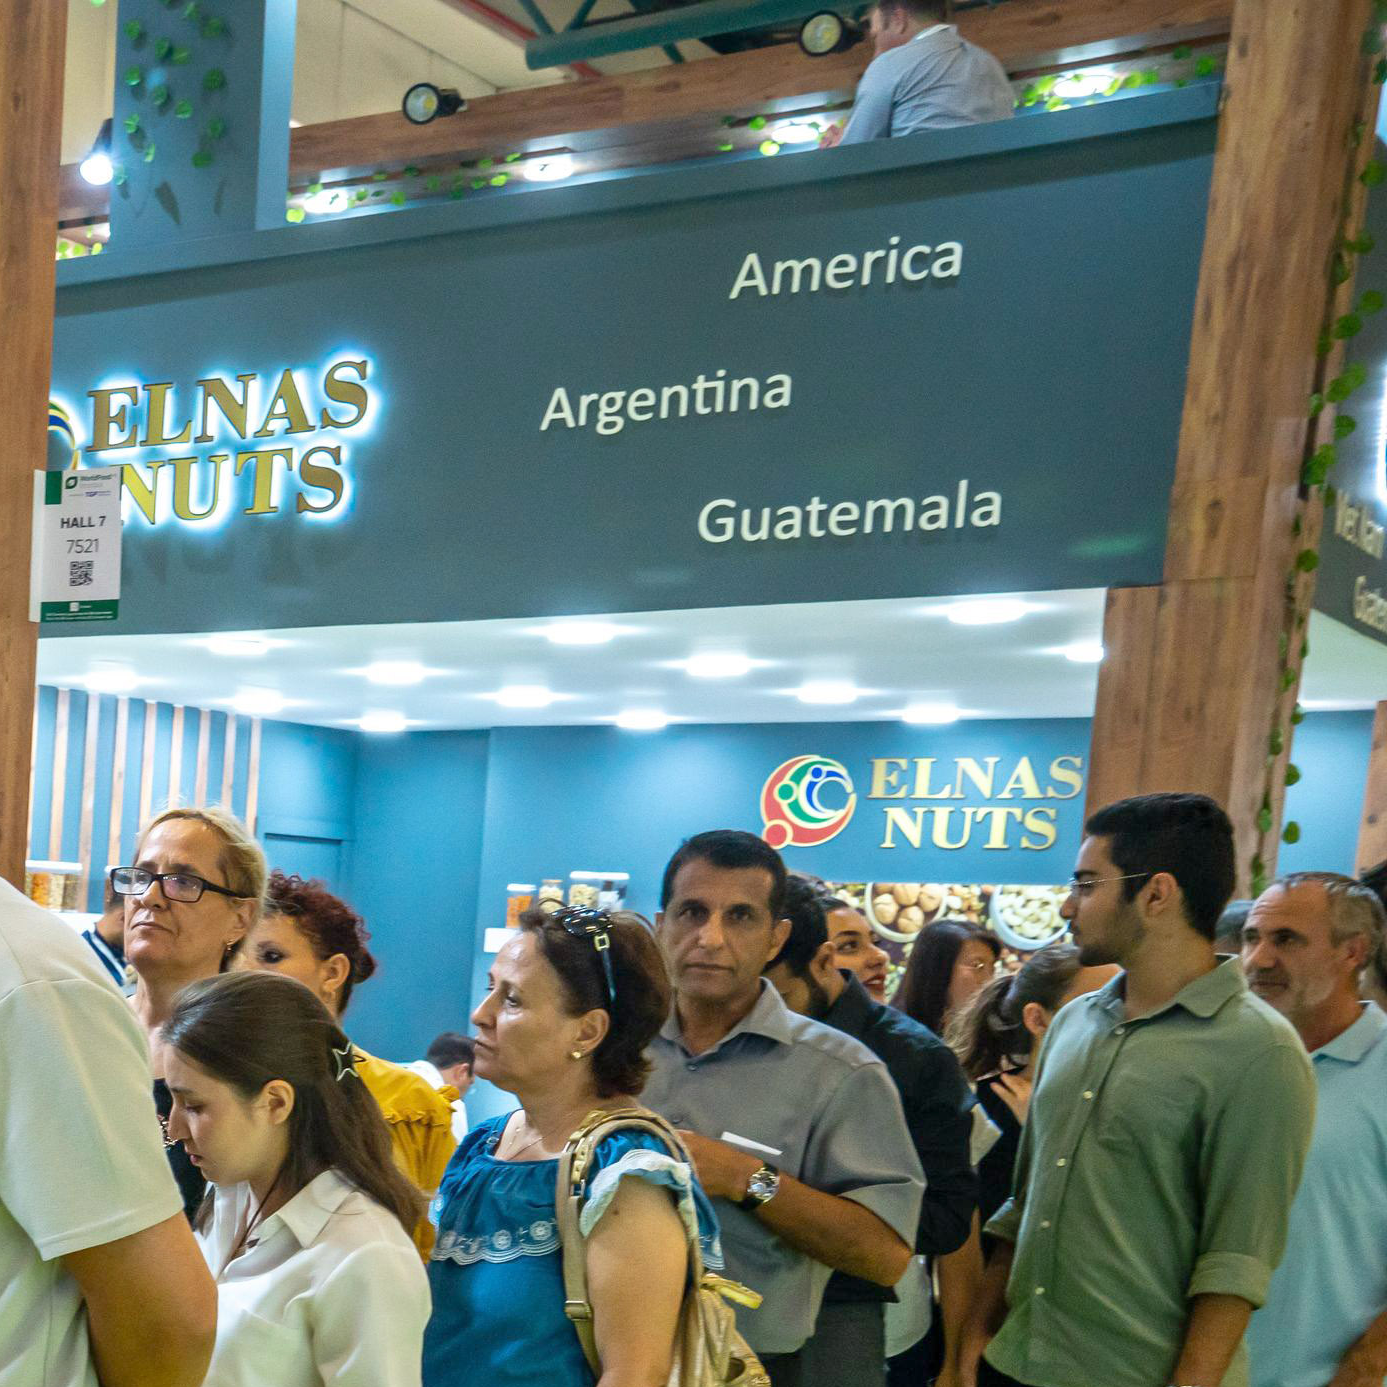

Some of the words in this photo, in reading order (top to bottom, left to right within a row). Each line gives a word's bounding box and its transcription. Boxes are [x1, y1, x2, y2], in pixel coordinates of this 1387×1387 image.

[730, 236, 964, 300] America
[85, 359, 369, 453] ELNAS
[540, 369, 793, 435] Argentina
[122, 445, 344, 526] NUTS
[698, 480, 1004, 544] Guatemala
[60, 517, 95, 528] HALL
[98, 516, 107, 526] 7
[67, 539, 100, 554] 7521
[867, 755, 1084, 800] ELNAS
[880, 806, 1058, 851] NUTS
